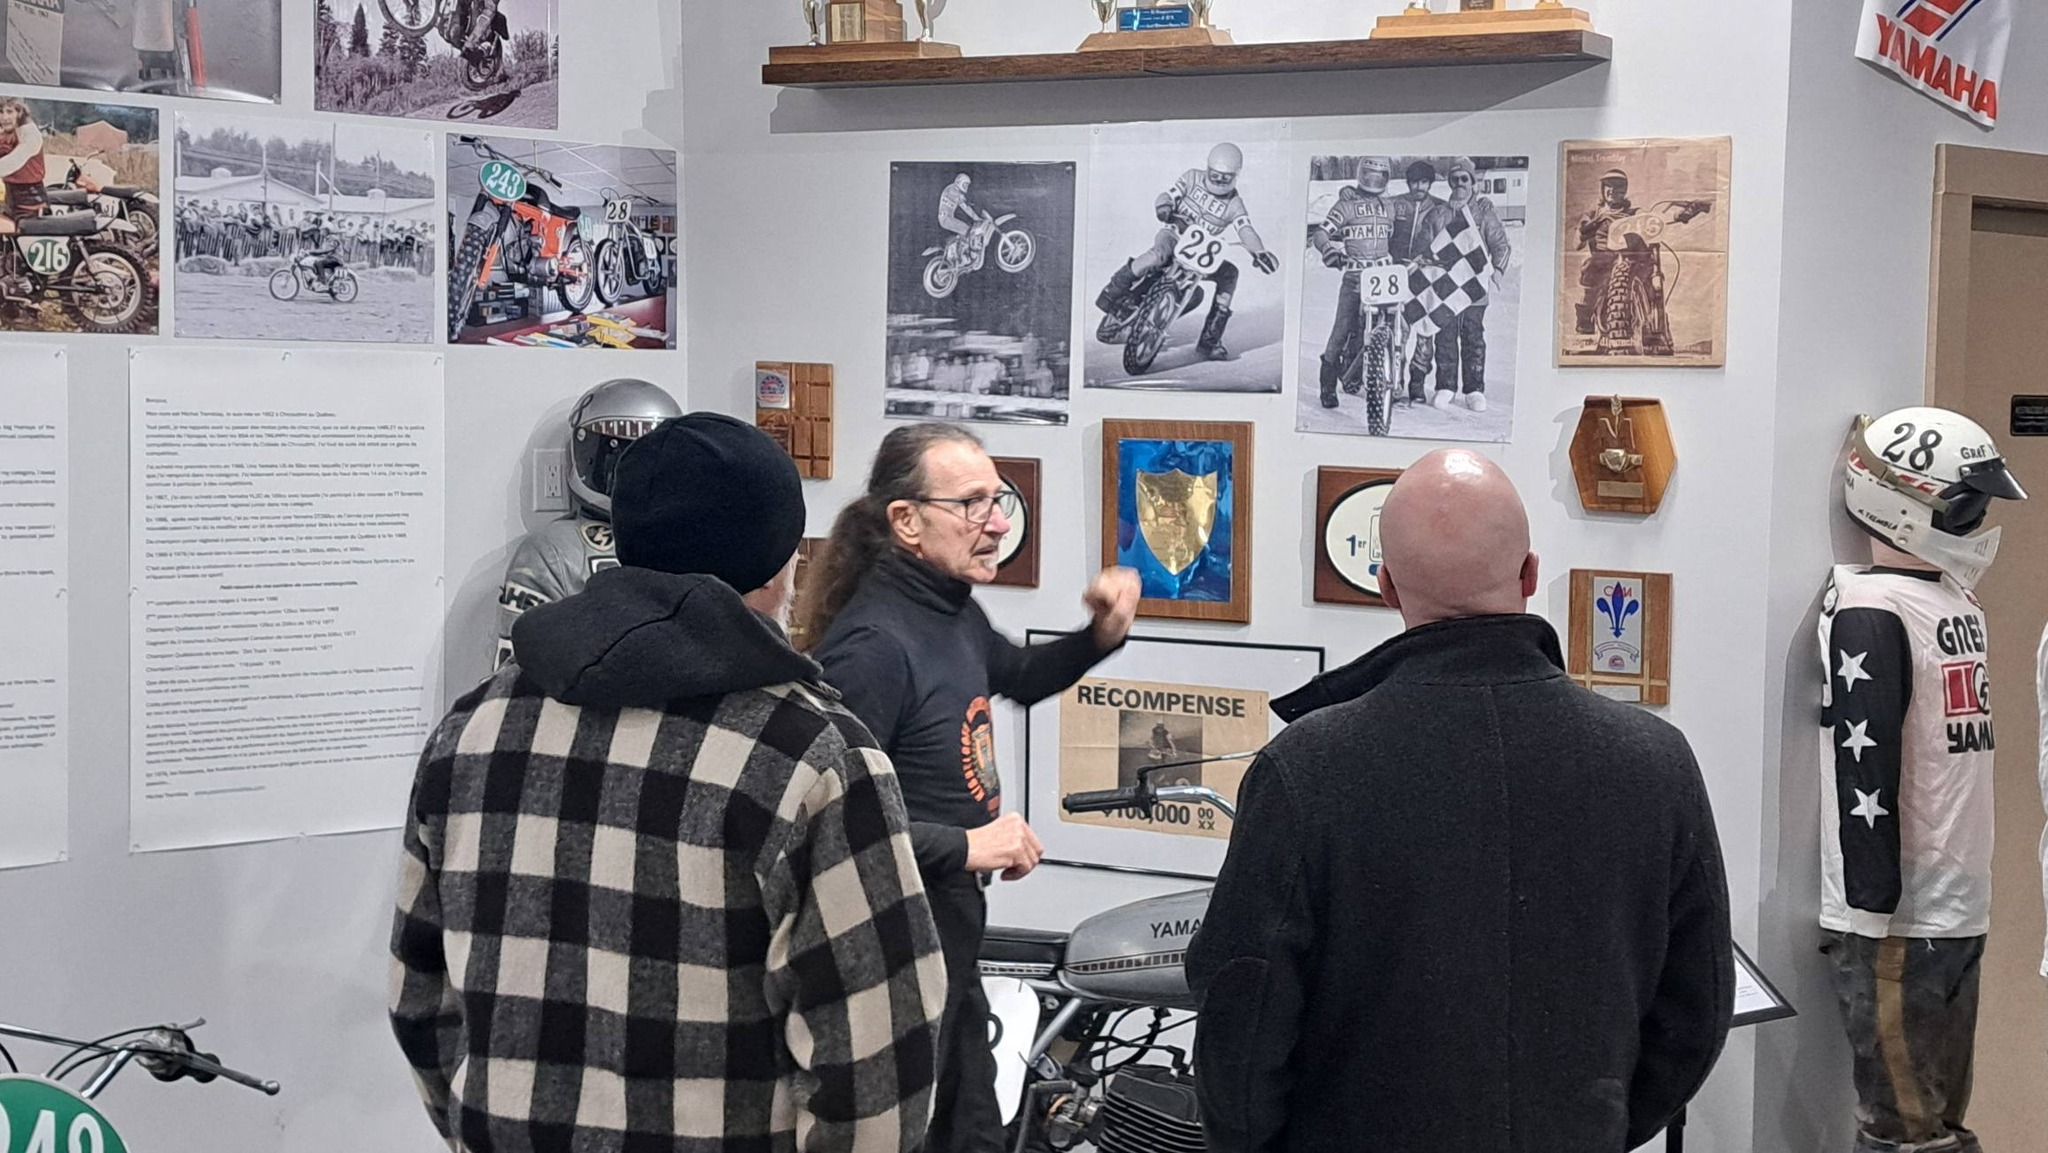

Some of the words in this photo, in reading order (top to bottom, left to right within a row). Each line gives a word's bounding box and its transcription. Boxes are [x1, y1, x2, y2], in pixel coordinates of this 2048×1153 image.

[1876, 13, 1997, 120] YAMAHA
[487, 163, 521, 198] 243
[607, 201, 628, 220] 28
[1192, 187, 1225, 214] GREF
[30, 241, 66, 272] 216
[1178, 229, 1222, 268] 28
[1369, 274, 1399, 296] 28
[1882, 422, 1943, 472] 28
[1936, 614, 1986, 656] GRE
[1077, 682, 1246, 718] RÉCOMPENSE
[1946, 720, 1995, 754] YAM
[1150, 918, 1202, 939] YAMA
